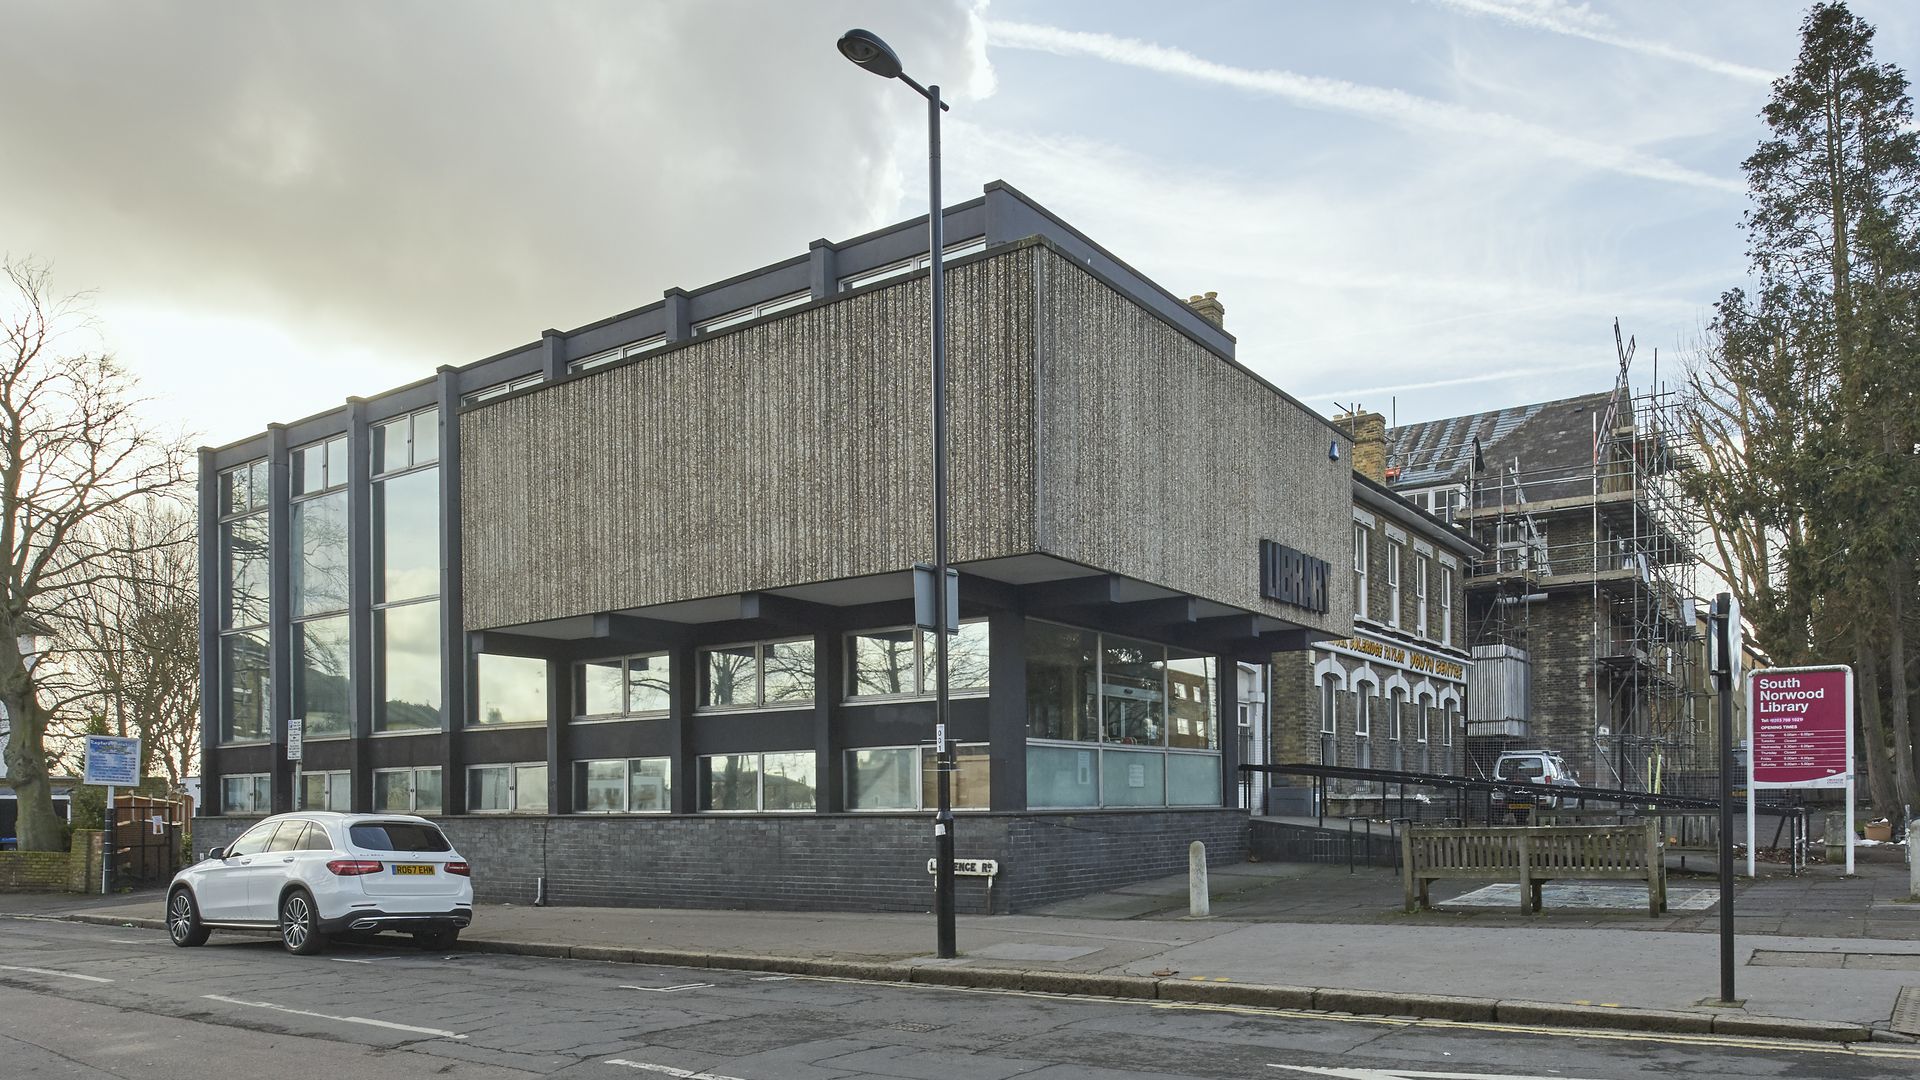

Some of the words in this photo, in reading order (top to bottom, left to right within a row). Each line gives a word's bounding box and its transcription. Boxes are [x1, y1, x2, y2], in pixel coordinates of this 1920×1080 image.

[1260, 539, 1331, 614] LIBRARY
[1410, 651, 1434, 674] YOUTH
[1435, 660, 1463, 680] CENTRE
[1760, 678, 1800, 689] South
[1760, 688, 1824, 701] Norwood
[1760, 702, 1809, 713] Library
[397, 865, 416, 874] RO67
[930, 862, 976, 872] LENCE
